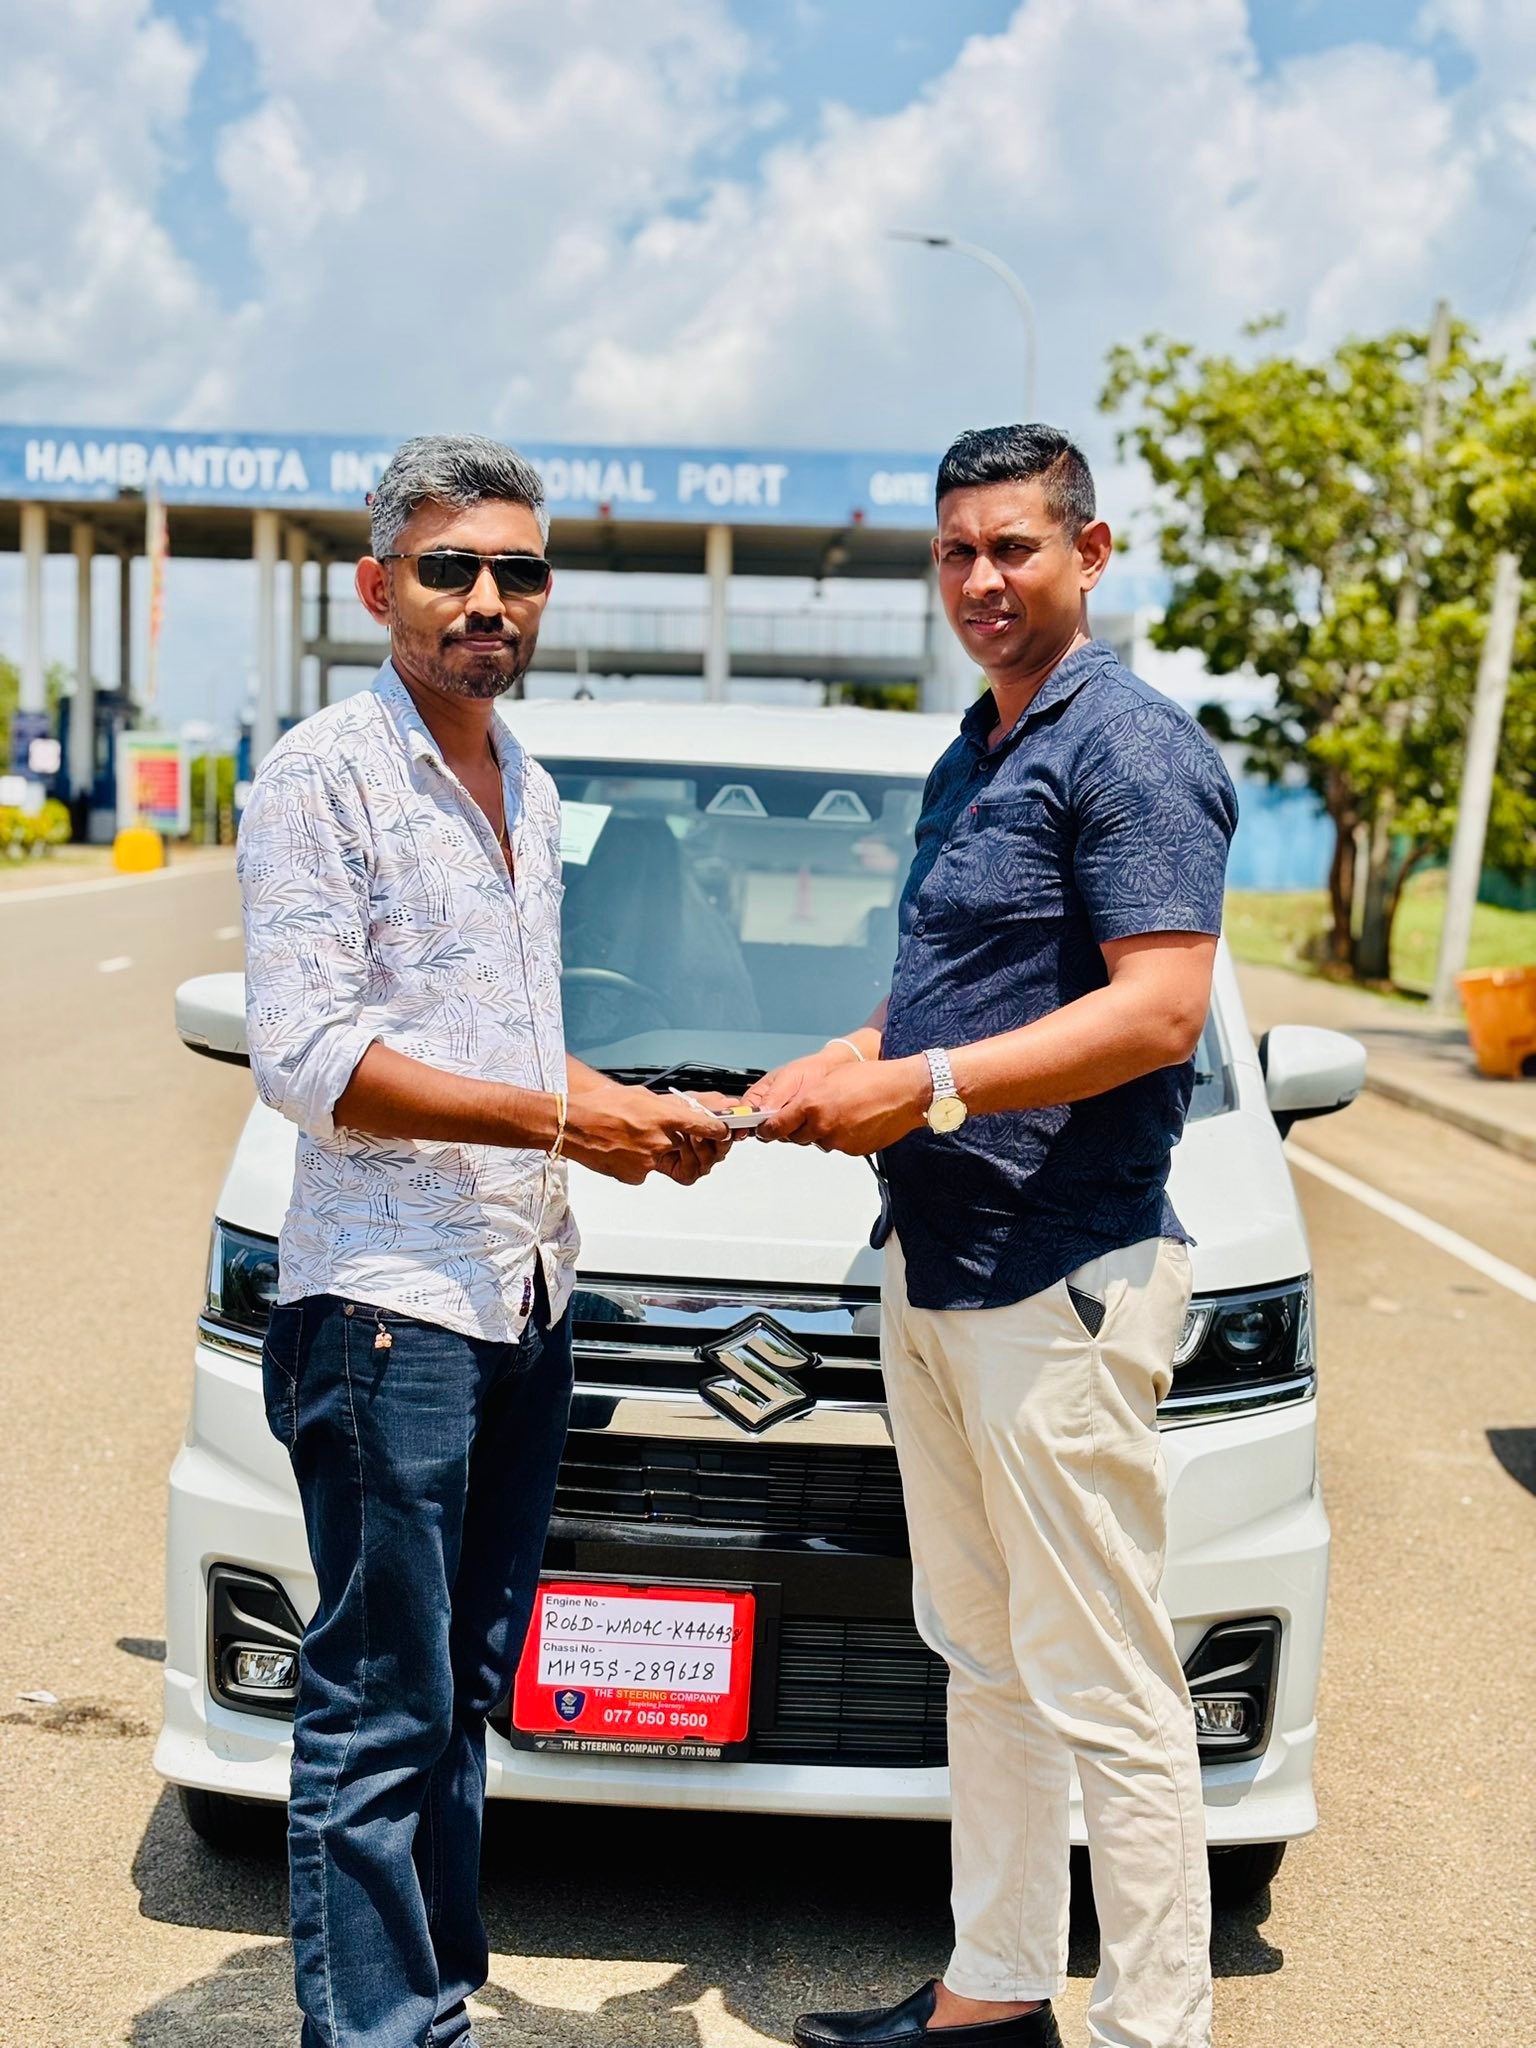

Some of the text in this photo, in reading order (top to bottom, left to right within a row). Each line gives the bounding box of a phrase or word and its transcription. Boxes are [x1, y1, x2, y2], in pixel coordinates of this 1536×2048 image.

[25, 440, 309, 491] HAMBANTOTA
[678, 463, 788, 507] PORT
[545, 1596, 581, 1608] Engine
[584, 1598, 598, 1608] No
[543, 1642, 578, 1653] Chassi
[581, 1644, 595, 1654] No
[593, 1688, 720, 1704] THE STEERING COMPANY
[604, 1708, 708, 1728] 077 050 9500
[562, 1740, 579, 1750] THE
[580, 1741, 621, 1753] STEERING
[623, 1743, 664, 1755] COMPANY
[681, 1746, 696, 1756] 0770
